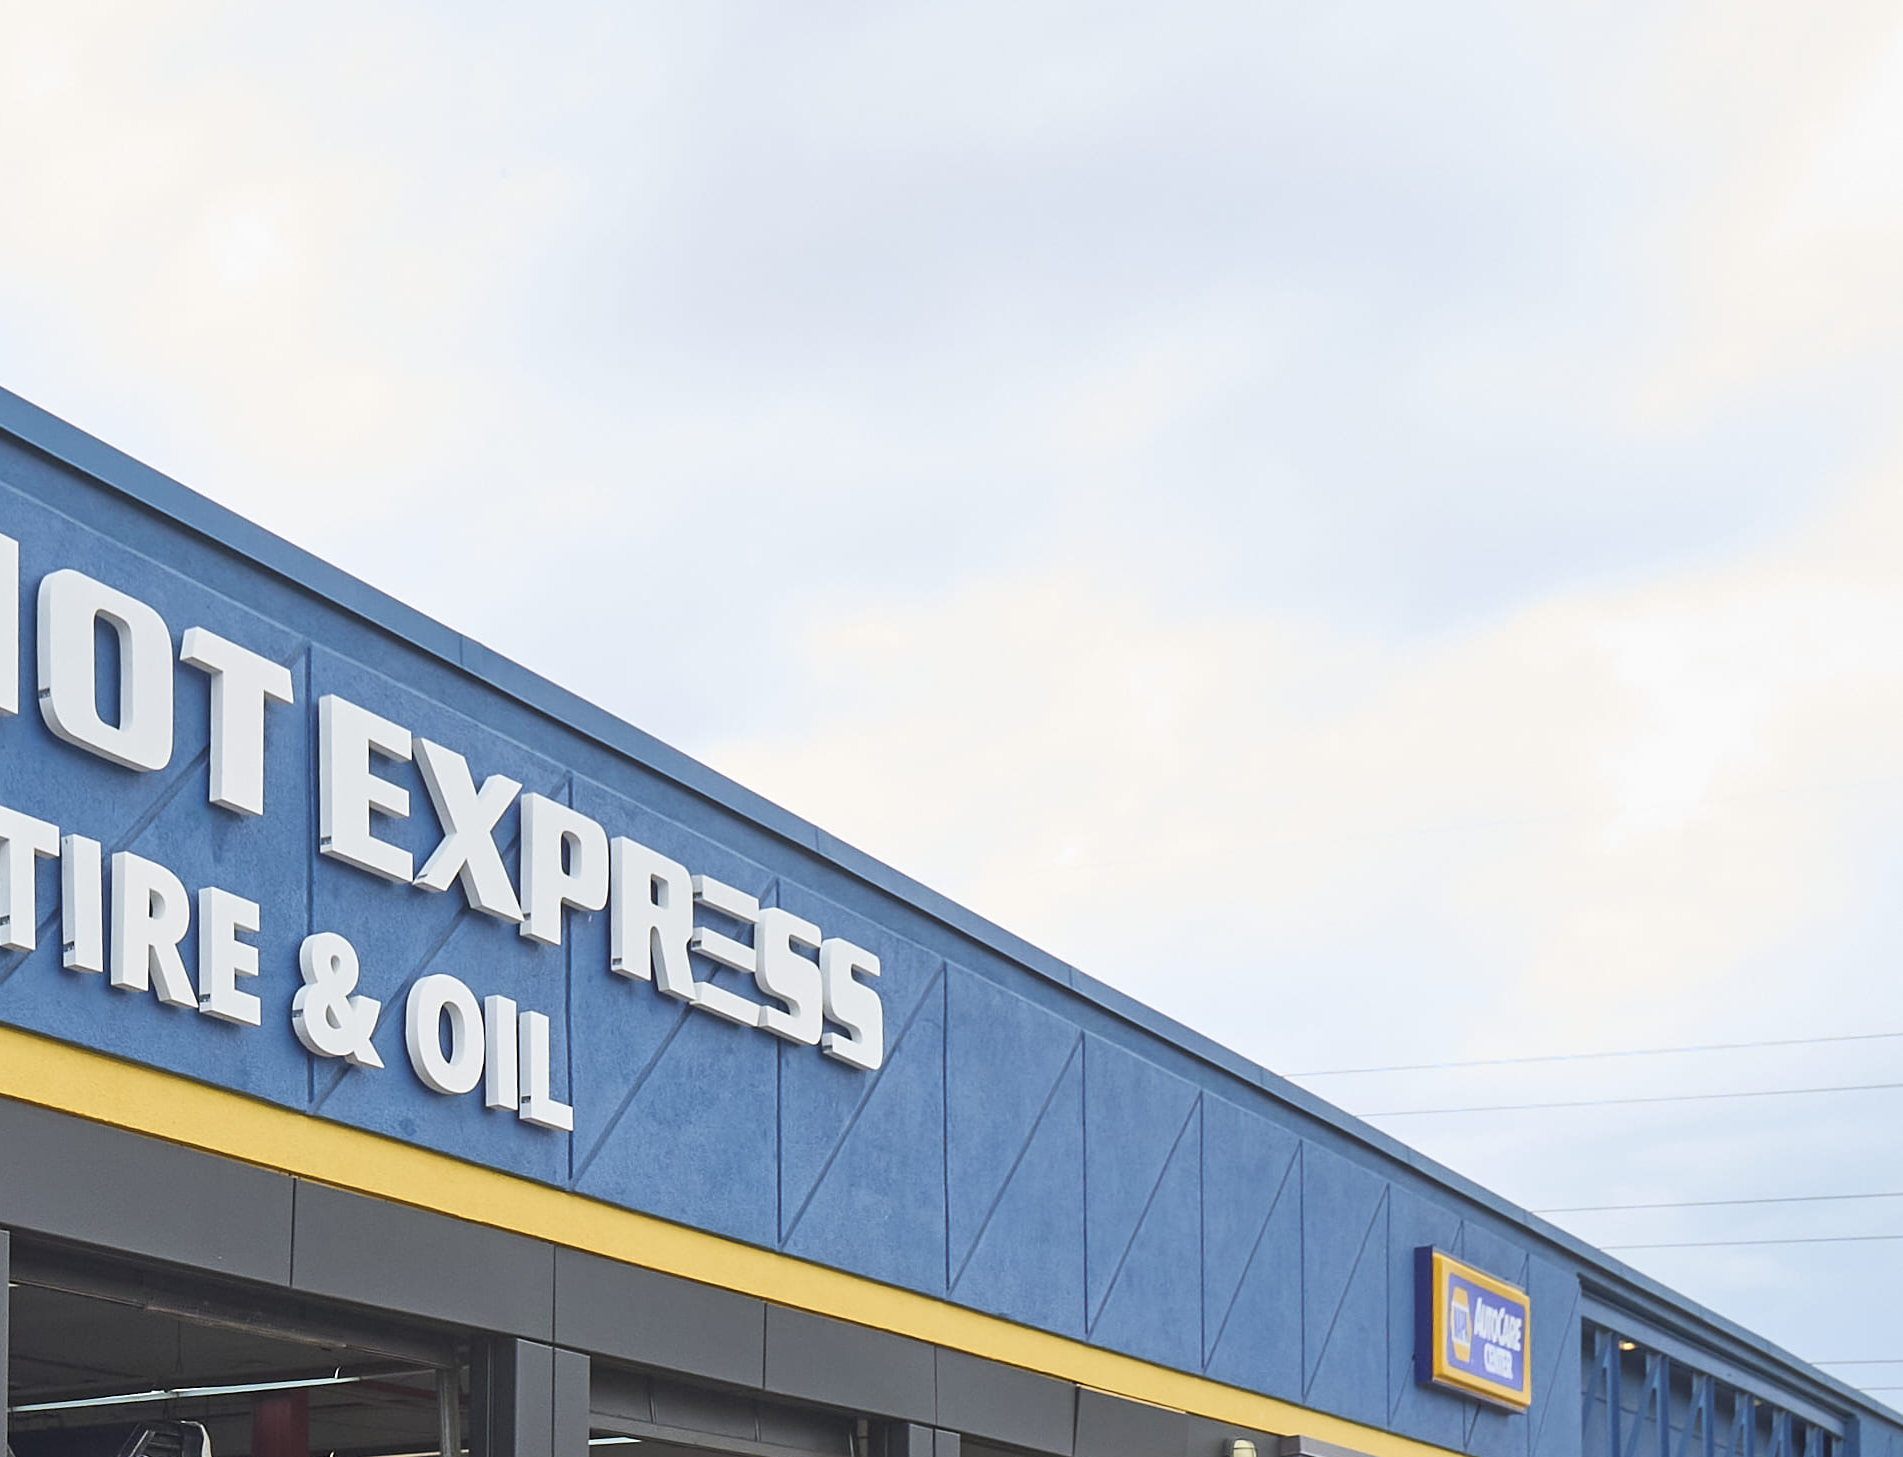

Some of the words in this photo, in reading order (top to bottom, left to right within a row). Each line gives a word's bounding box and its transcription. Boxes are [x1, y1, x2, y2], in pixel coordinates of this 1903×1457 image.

[318, 693, 883, 1072] EXPRESS
[291, 930, 386, 1070] &
[404, 972, 574, 1132] OIL
